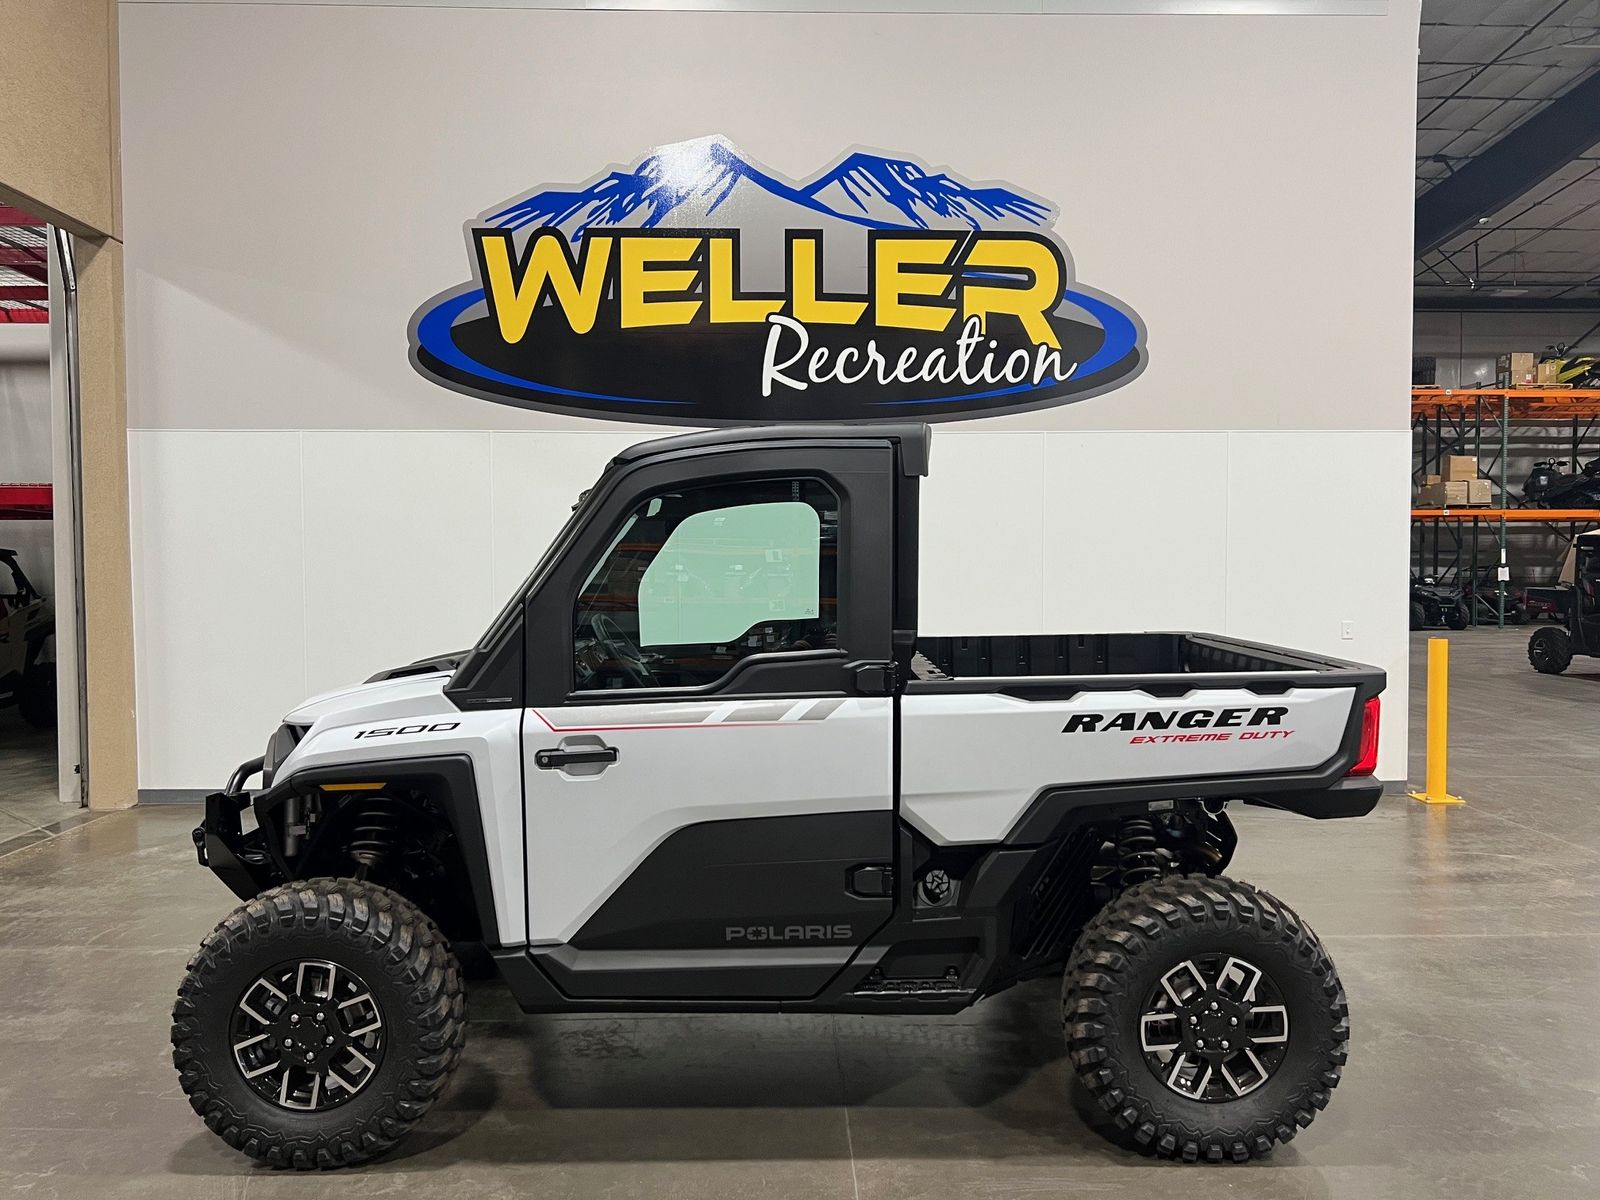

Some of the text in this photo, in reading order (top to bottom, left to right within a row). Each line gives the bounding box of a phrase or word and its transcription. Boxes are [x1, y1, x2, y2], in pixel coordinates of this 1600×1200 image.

[480, 234, 1063, 349] WELLER
[762, 313, 1079, 398] Recreation
[354, 722, 461, 740] 1500
[1060, 706, 1290, 734] RANGER
[1128, 729, 1296, 745] EXTREME DUTY
[725, 925, 853, 942] POLARIS
